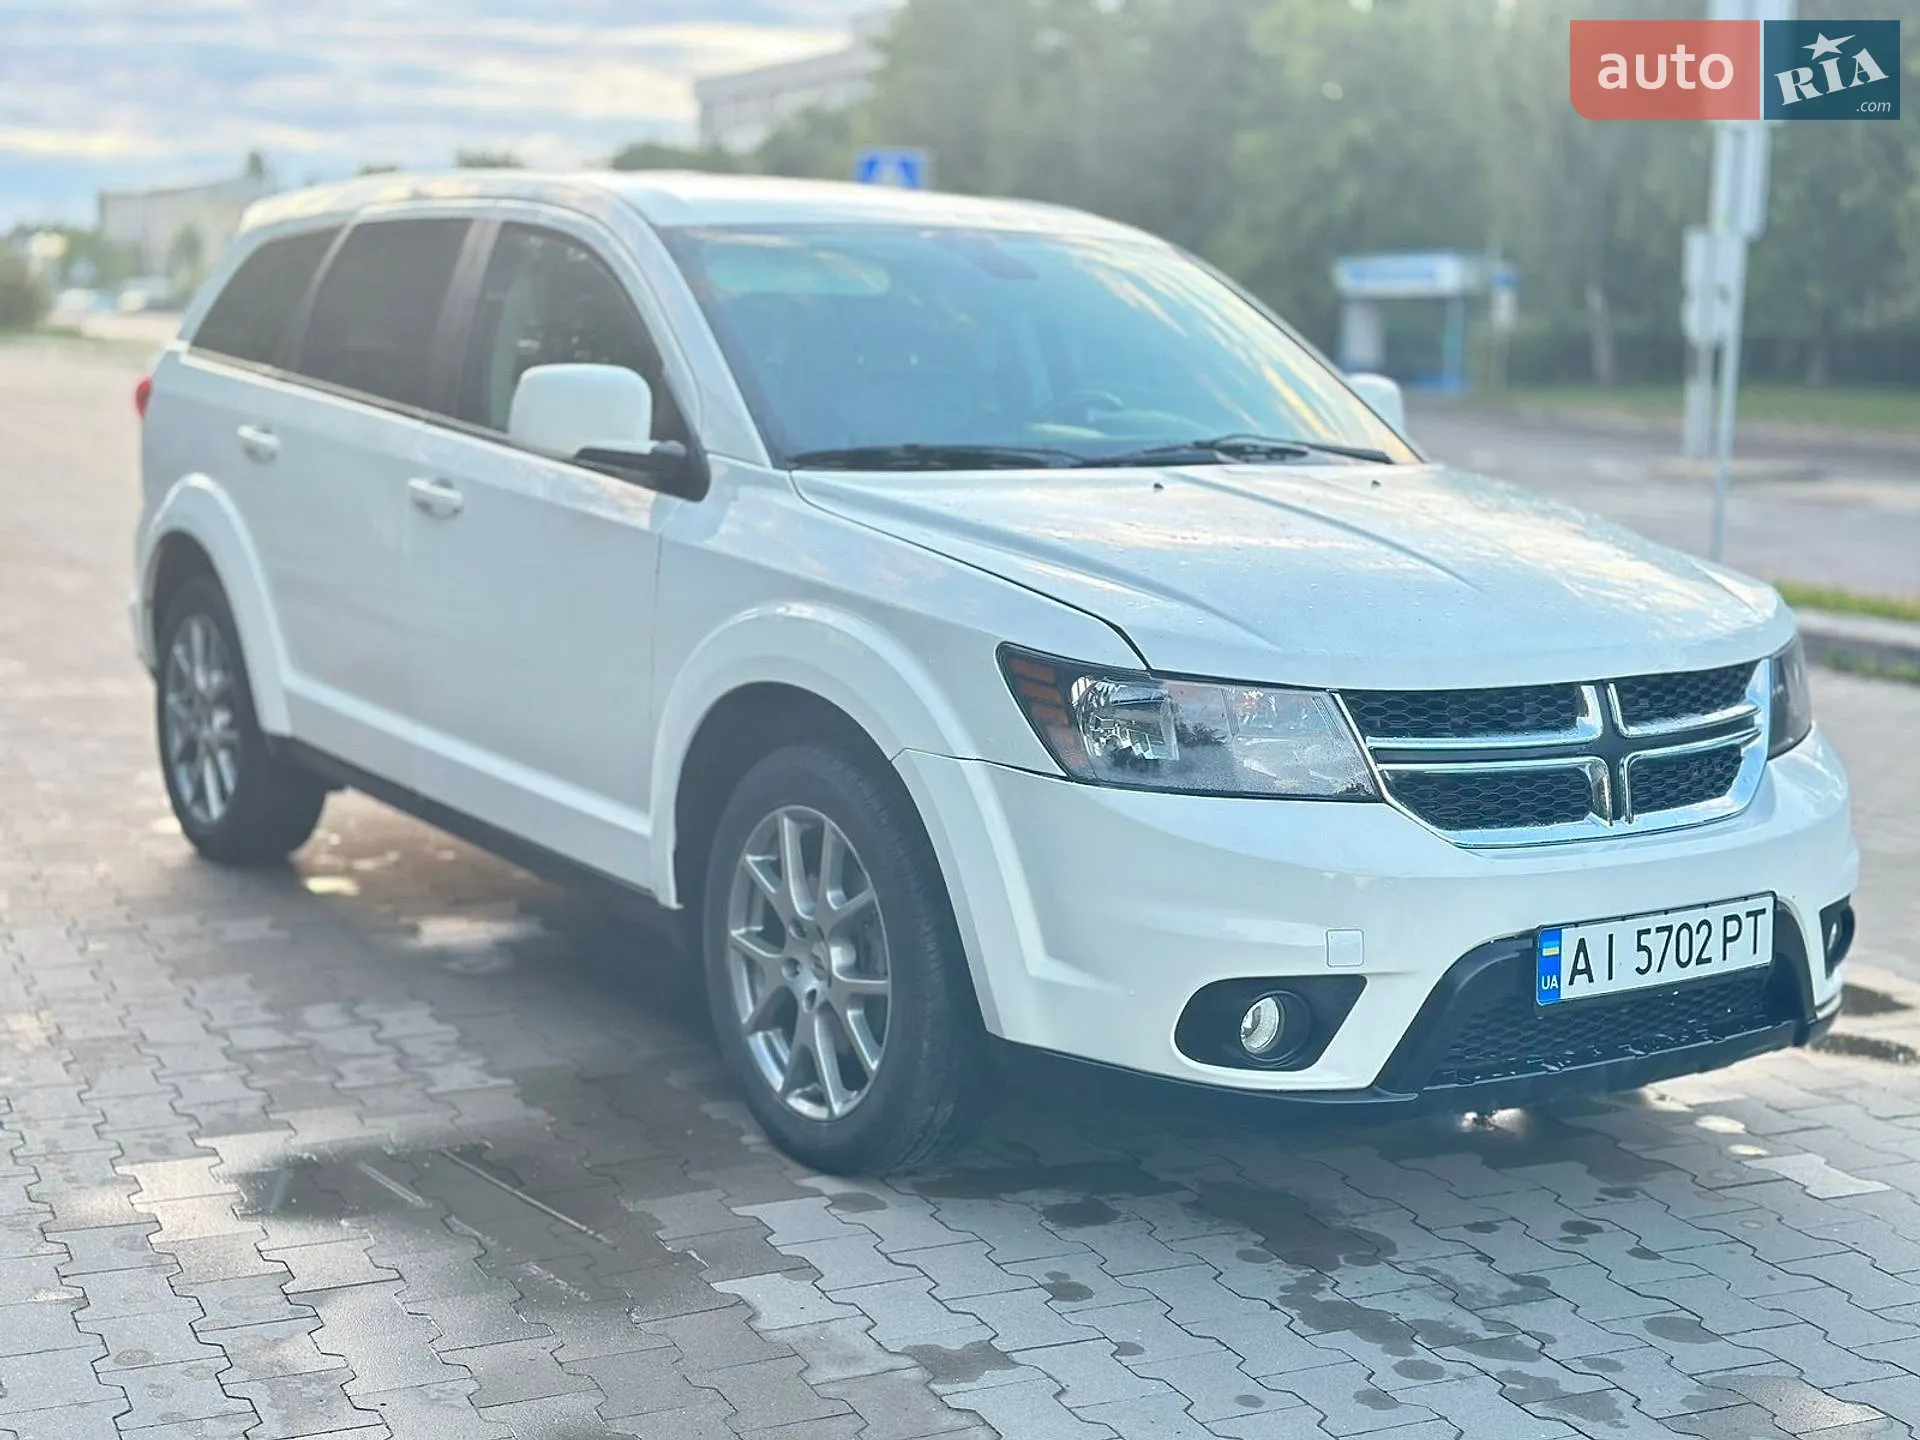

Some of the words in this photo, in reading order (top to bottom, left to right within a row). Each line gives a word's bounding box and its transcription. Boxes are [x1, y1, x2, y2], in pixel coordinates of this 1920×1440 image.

[1568, 934, 1614, 986] AI
[1635, 919, 1712, 975] 5702
[1722, 908, 1766, 961] PT
[1541, 976, 1559, 990] UA
